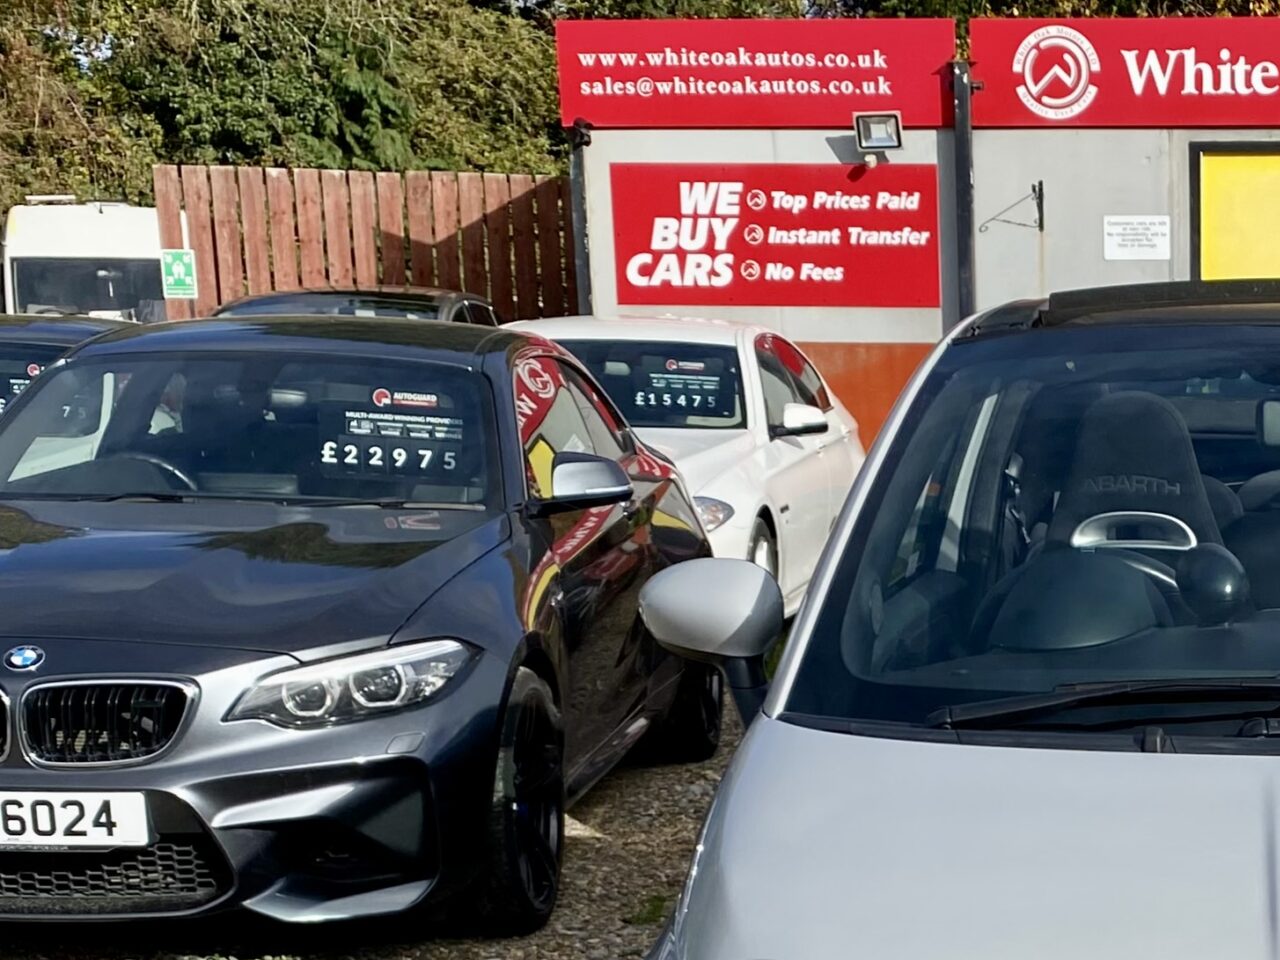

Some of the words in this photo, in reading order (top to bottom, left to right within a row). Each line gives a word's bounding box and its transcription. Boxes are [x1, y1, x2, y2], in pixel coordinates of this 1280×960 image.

[577, 47, 888, 69] www.whiteoakautos.co.uk
[1121, 47, 1280, 96] White
[580, 76, 892, 98] sales@whiteoakautos.co.uk
[679, 182, 744, 216] WE
[770, 191, 808, 214] Top
[812, 190, 871, 210] Prices
[875, 191, 921, 211] Paid
[650, 217, 740, 252] BUY
[767, 226, 841, 245] Instant
[847, 227, 931, 246] Transfer
[625, 252, 735, 288] CARS
[764, 262, 795, 281] No
[799, 262, 844, 282] Fees
[393, 392, 438, 402] AUTOGUARD
[635, 391, 716, 408] £15475
[321, 441, 456, 470] £22975
[1080, 474, 1182, 496] ABARTH
[1, 800, 118, 836] 6024
